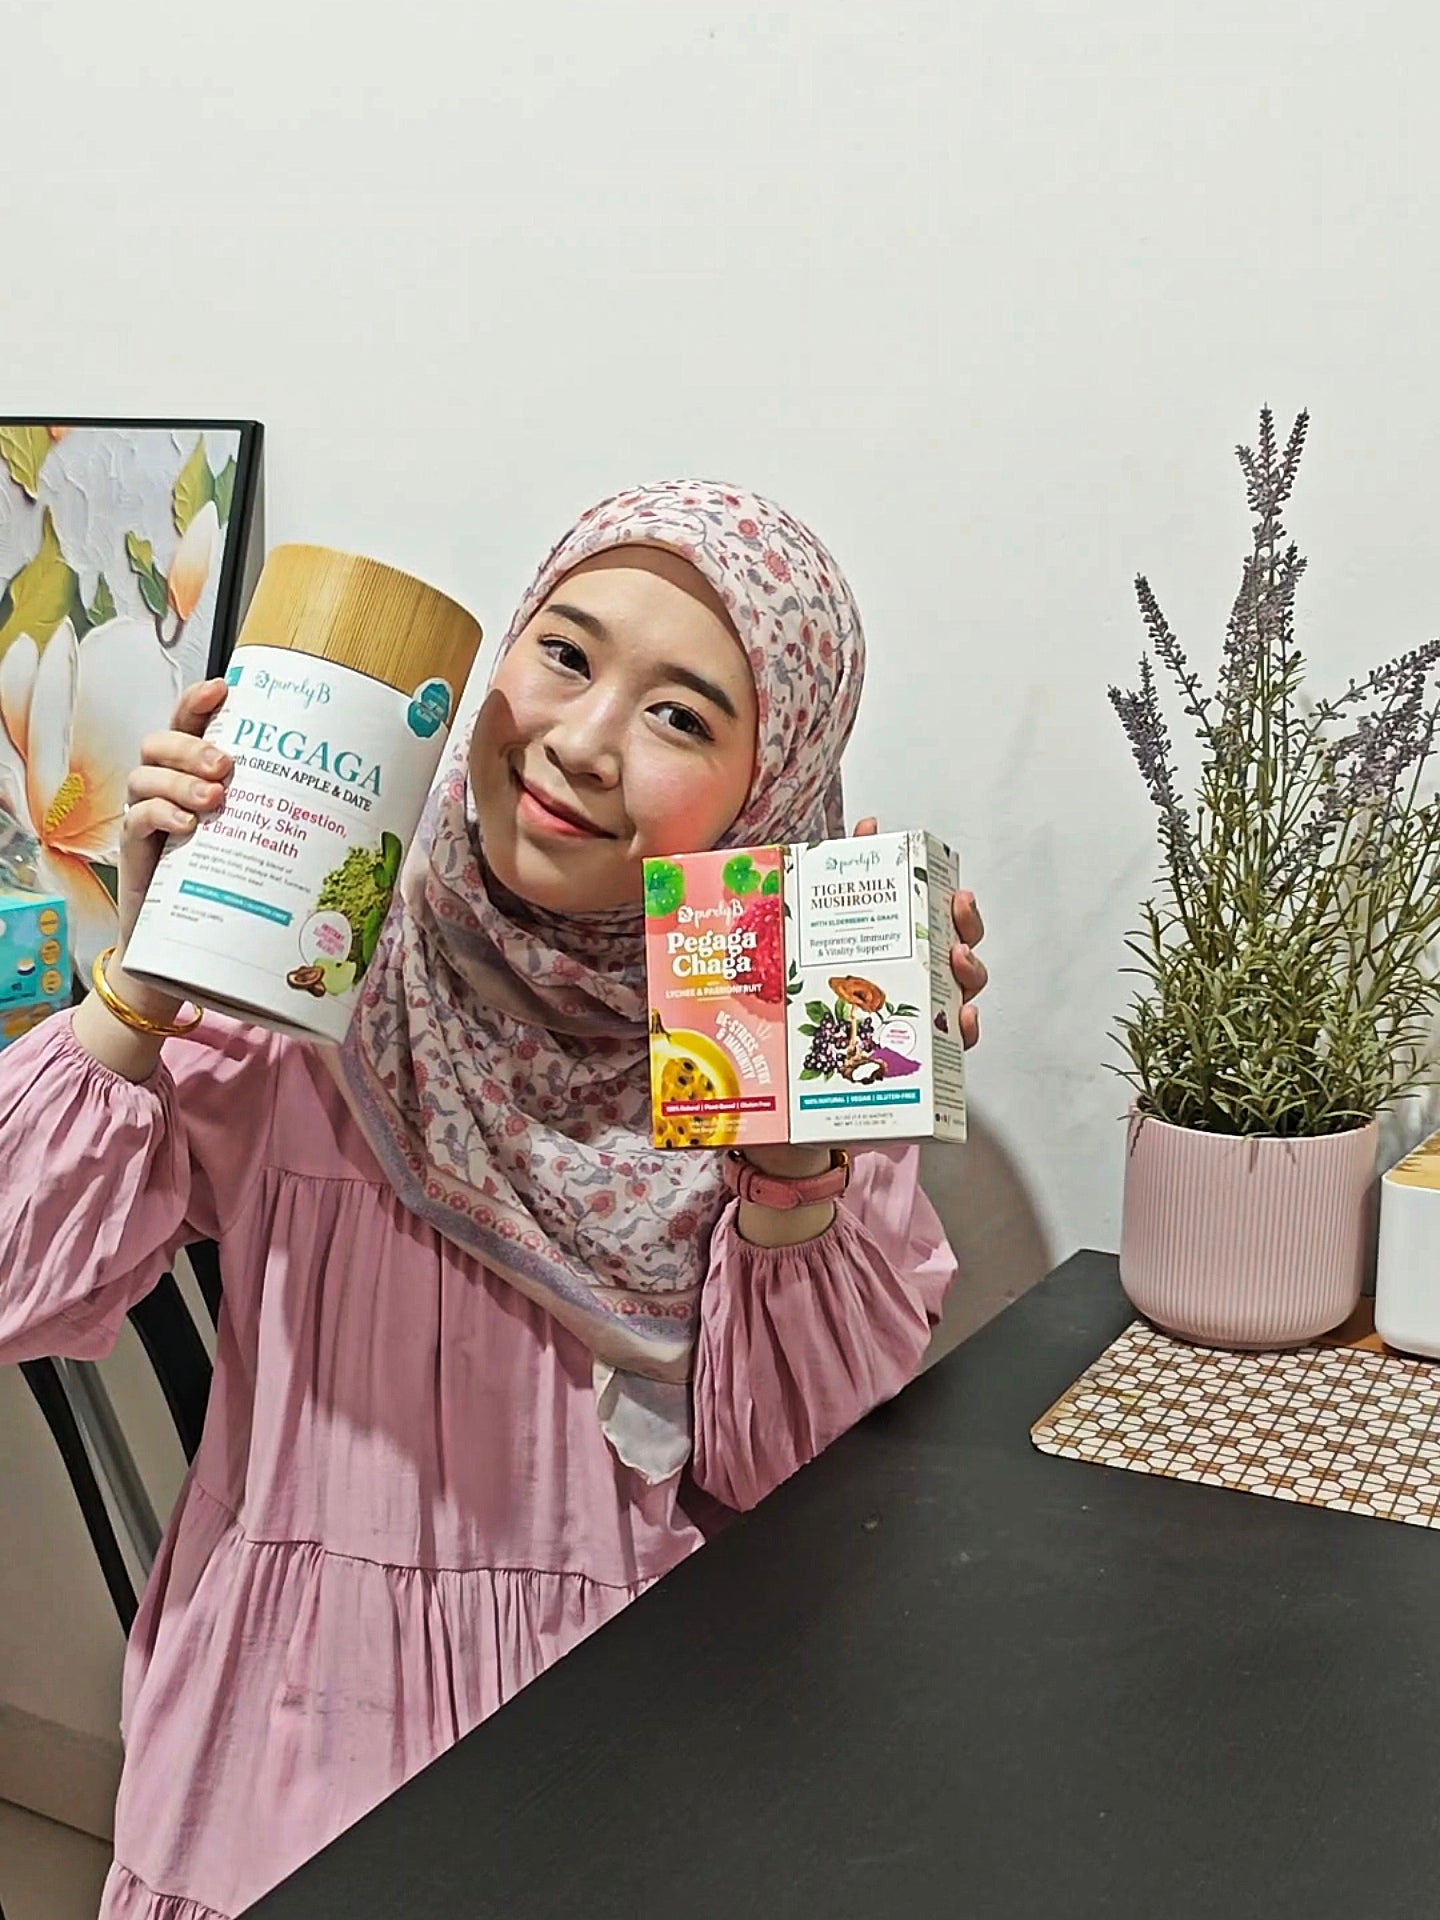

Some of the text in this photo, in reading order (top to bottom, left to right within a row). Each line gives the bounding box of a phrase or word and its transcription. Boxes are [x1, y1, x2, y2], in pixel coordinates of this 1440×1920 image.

[232, 718, 382, 798] PEGAGA
[249, 757, 291, 778] GREEN
[290, 770, 331, 793] APPLE
[331, 785, 342, 798] &
[342, 788, 373, 812] DATE
[274, 819, 307, 841] Skin
[276, 798, 348, 839] Digestion,
[213, 821, 247, 841] Brain
[249, 831, 298, 859] Health
[810, 890, 898, 911] MUSHROOM
[811, 877, 897, 898] TIGER MILK
[666, 927, 758, 958] Pegaga
[672, 952, 752, 980] Chaga
